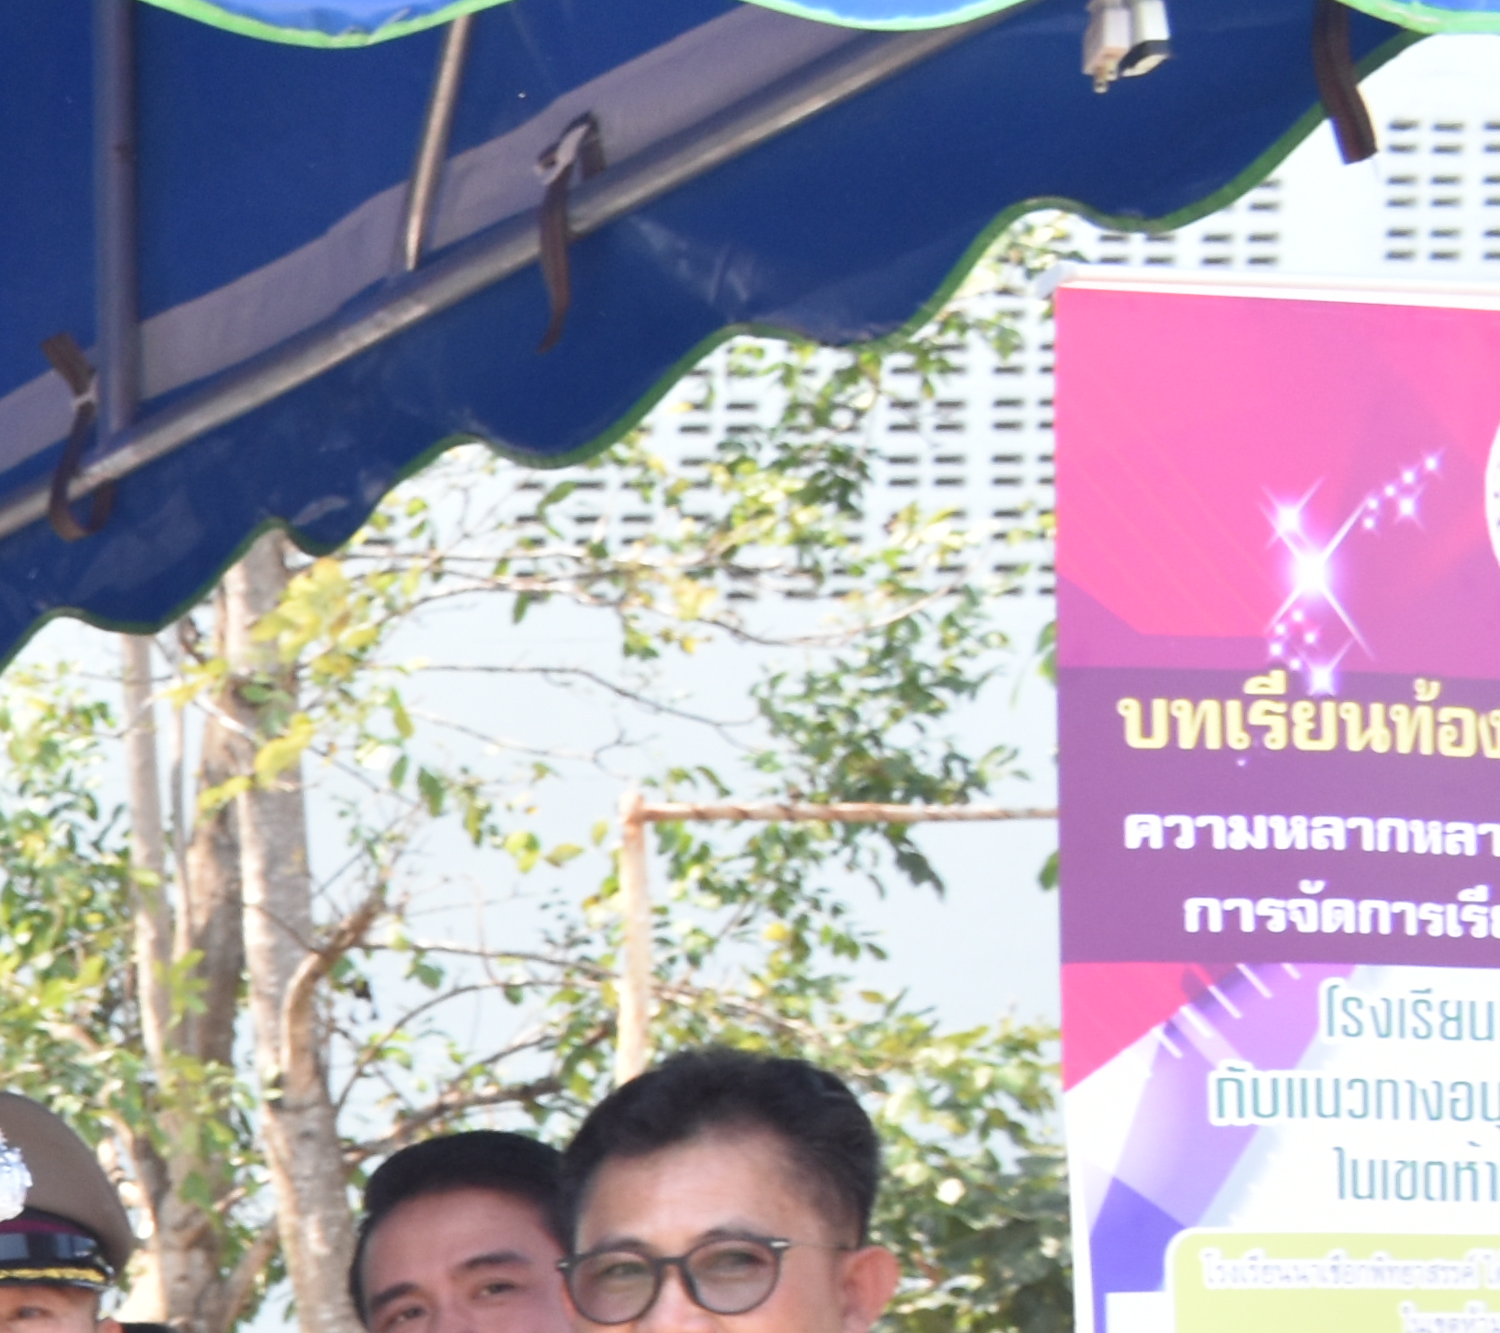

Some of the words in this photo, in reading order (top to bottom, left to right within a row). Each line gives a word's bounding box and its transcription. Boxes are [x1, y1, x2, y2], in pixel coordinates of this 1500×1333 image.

[1117, 669, 1500, 759] บทเรียนท้อง
[1326, 985, 1495, 1041] โรงเรียน
